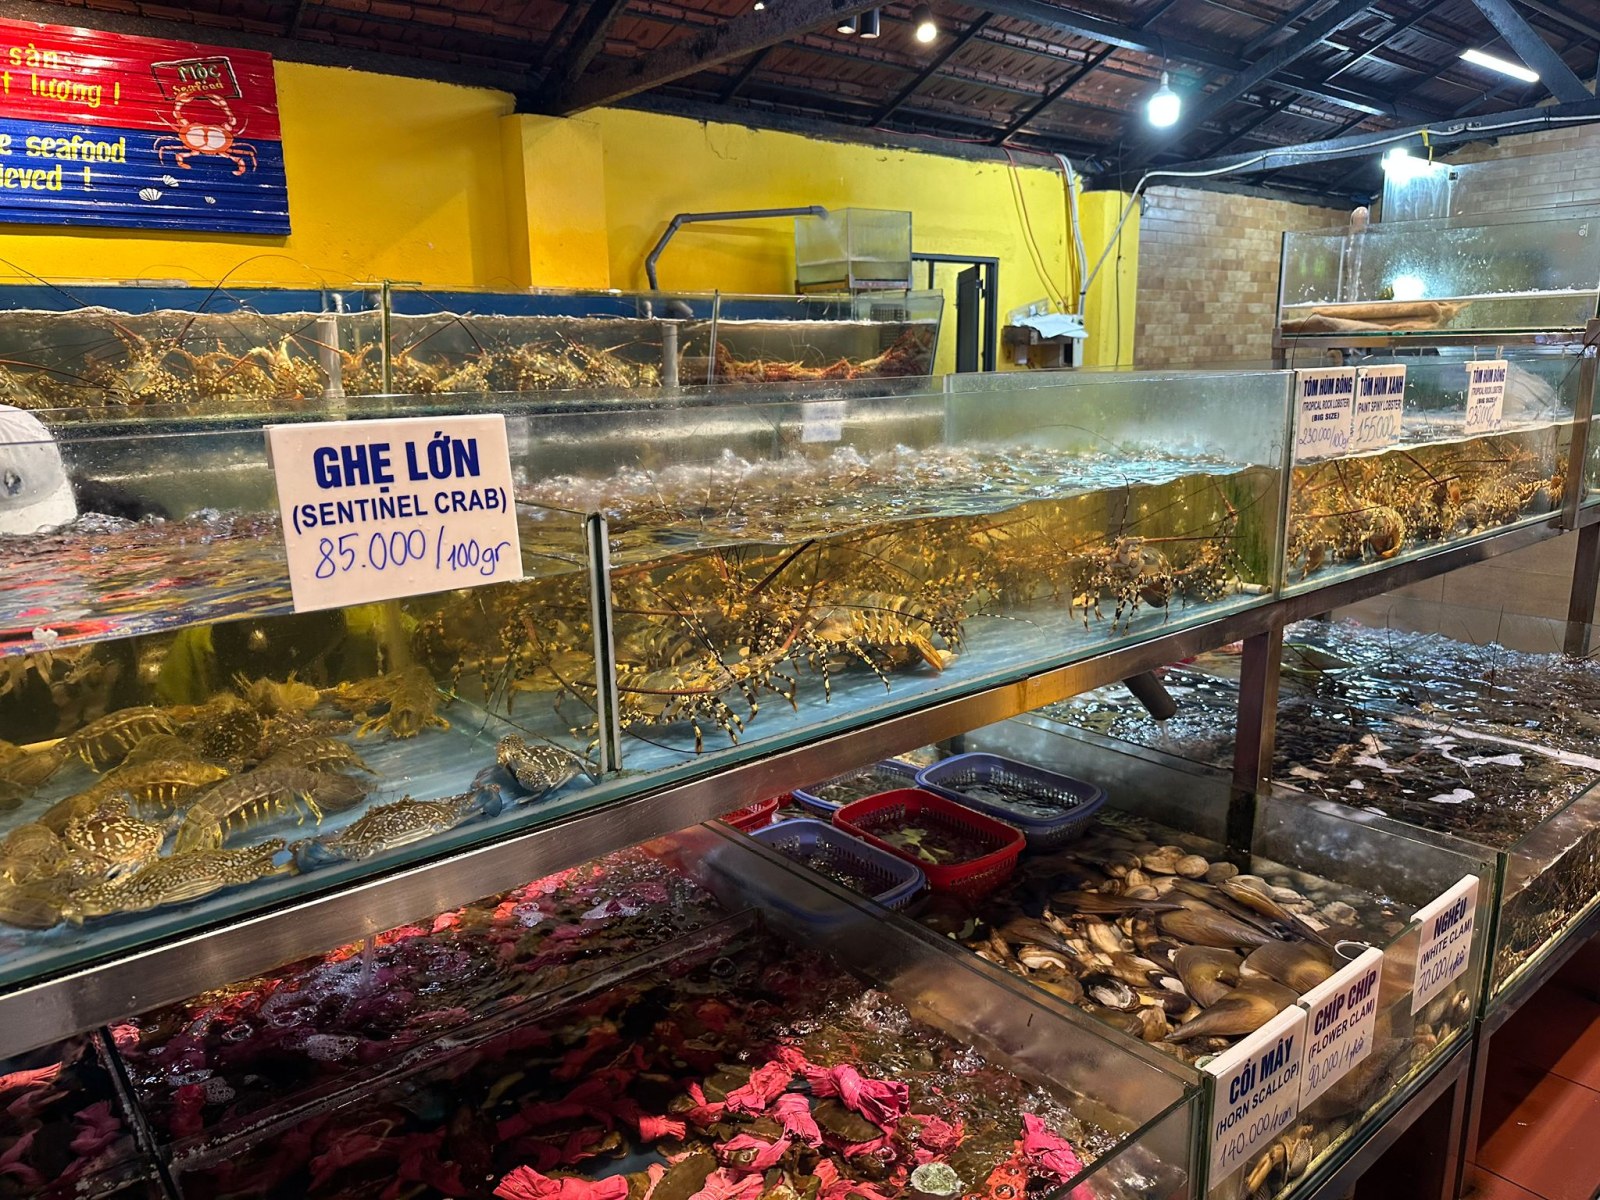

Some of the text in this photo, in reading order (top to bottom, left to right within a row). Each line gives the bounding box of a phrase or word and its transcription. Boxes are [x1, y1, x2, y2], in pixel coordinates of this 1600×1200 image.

[31, 72, 102, 108] lượng
[25, 134, 126, 163] seafood
[313, 431, 481, 493] GHẸ LỚN
[292, 486, 507, 535] (SENTINEL CRAB)
[1420, 917, 1472, 970] (WHITE CLAM)
[1433, 896, 1467, 940] NGHÊU
[1314, 968, 1377, 1036] CHÍP CHÍP
[1308, 997, 1375, 1064] (FLOWER CLAM)
[1259, 1034, 1294, 1084] MÂY
[1215, 1060, 1300, 1142] (HORN SCALLOP)
